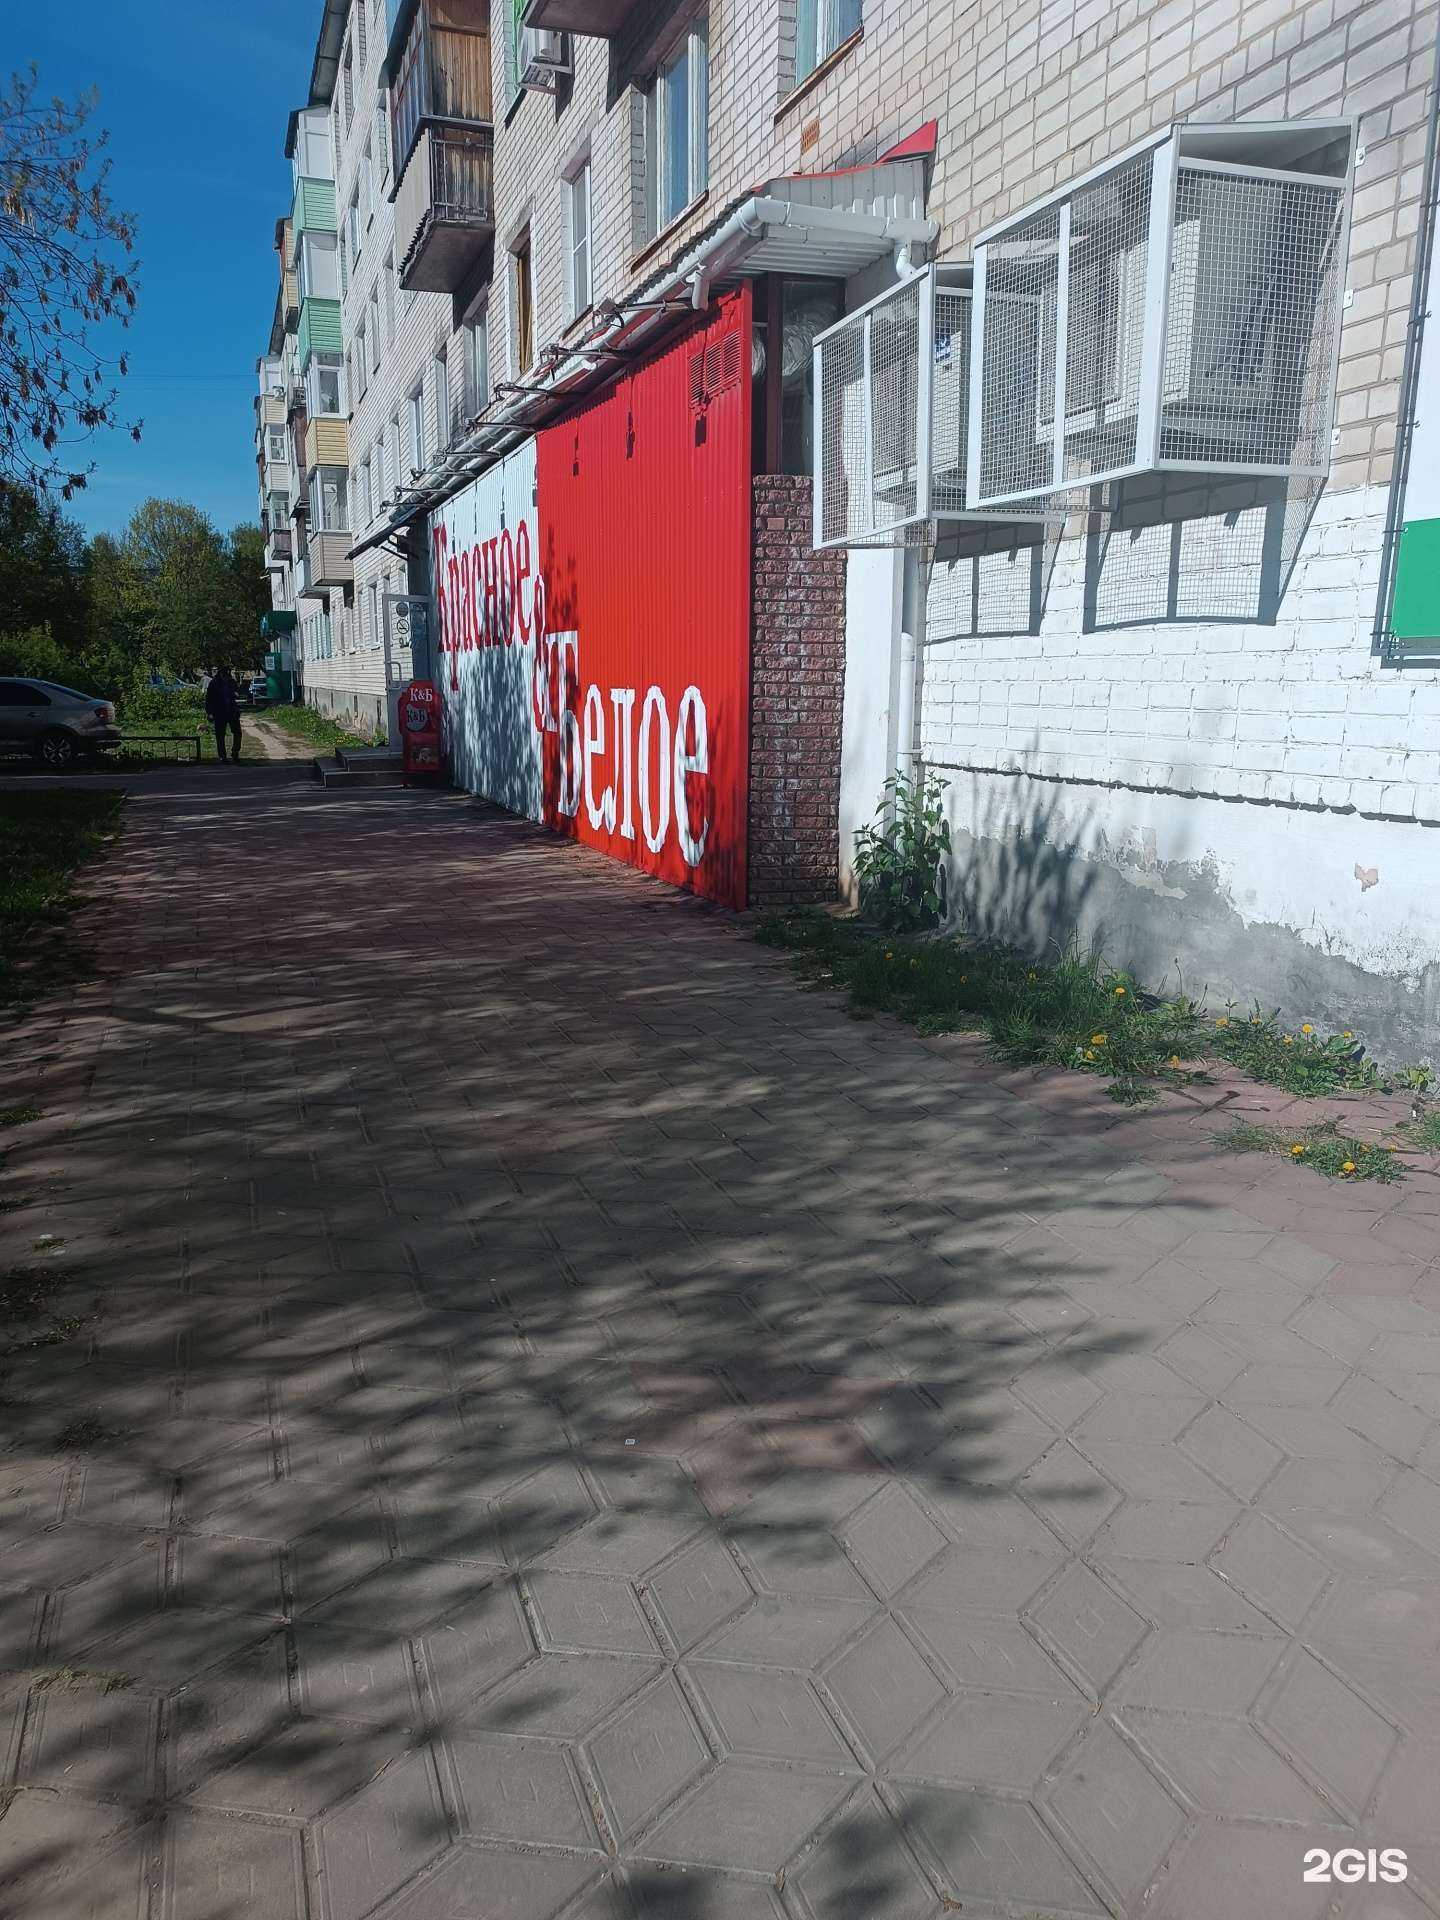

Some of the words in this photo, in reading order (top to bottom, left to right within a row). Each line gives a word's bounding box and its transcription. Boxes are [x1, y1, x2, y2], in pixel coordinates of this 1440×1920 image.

[409, 687, 433, 702] К&Б
[433, 520, 532, 691] Красное
[545, 630, 709, 868] Белое
